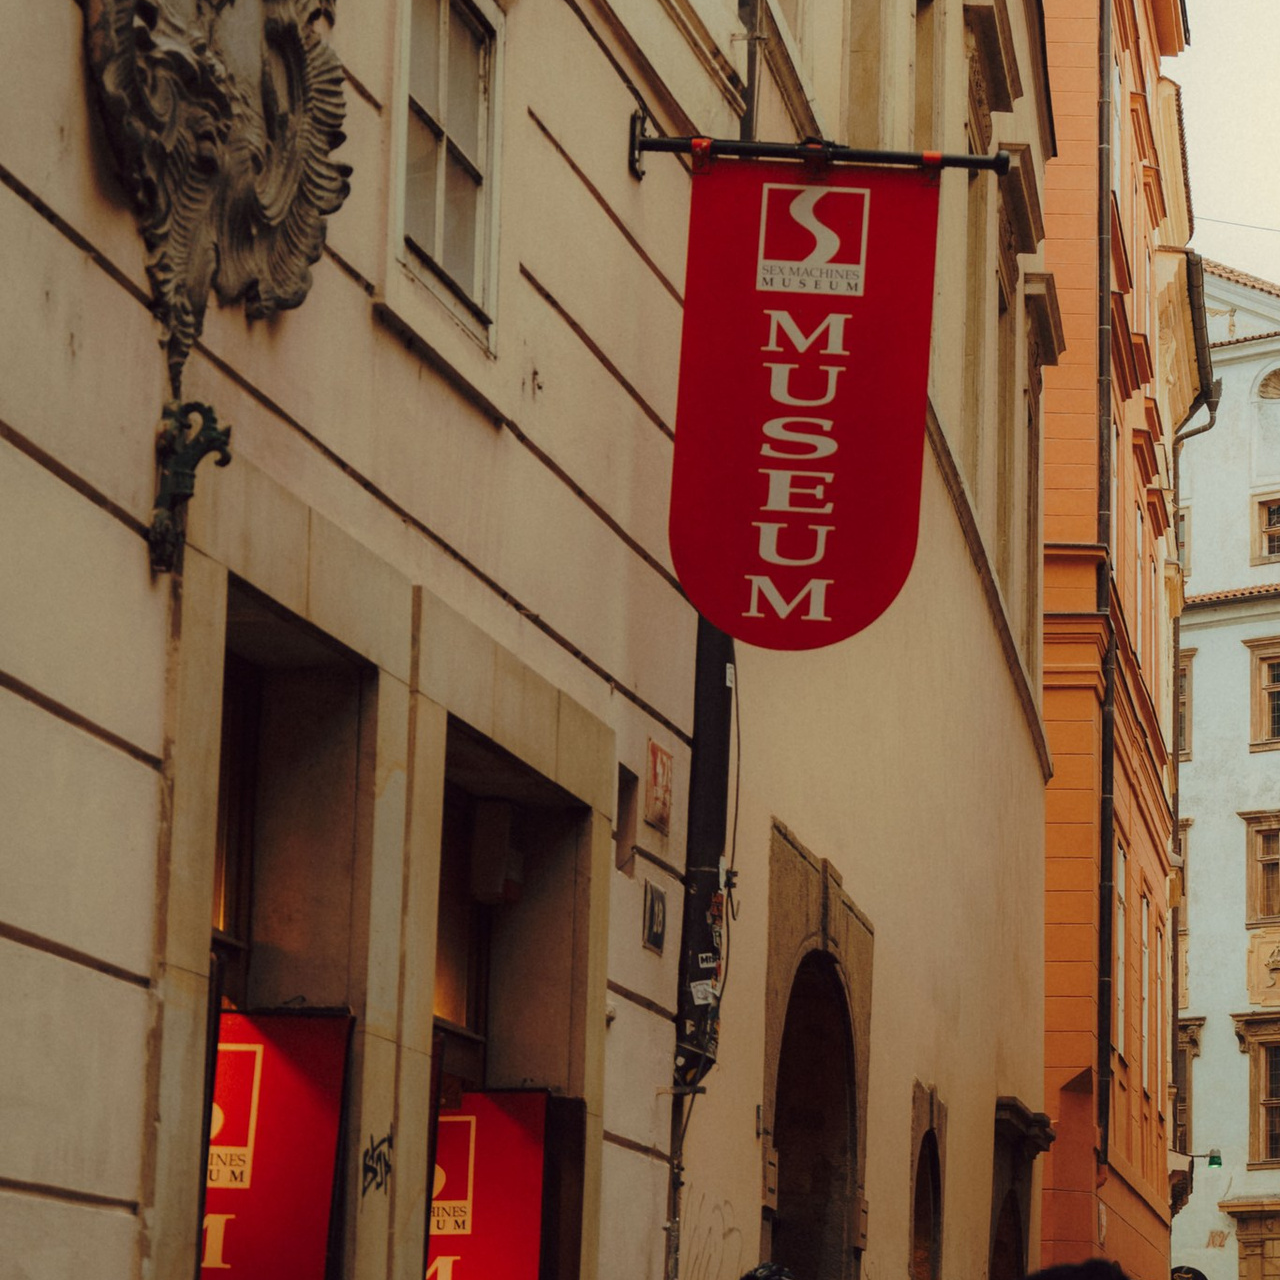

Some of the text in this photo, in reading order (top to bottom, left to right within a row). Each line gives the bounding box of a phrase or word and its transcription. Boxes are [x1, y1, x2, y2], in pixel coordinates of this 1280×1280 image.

[762, 265, 861, 281] SEX MACHINES
[761, 277, 860, 292] MUSEUM
[742, 309, 853, 621] MUSEUM
